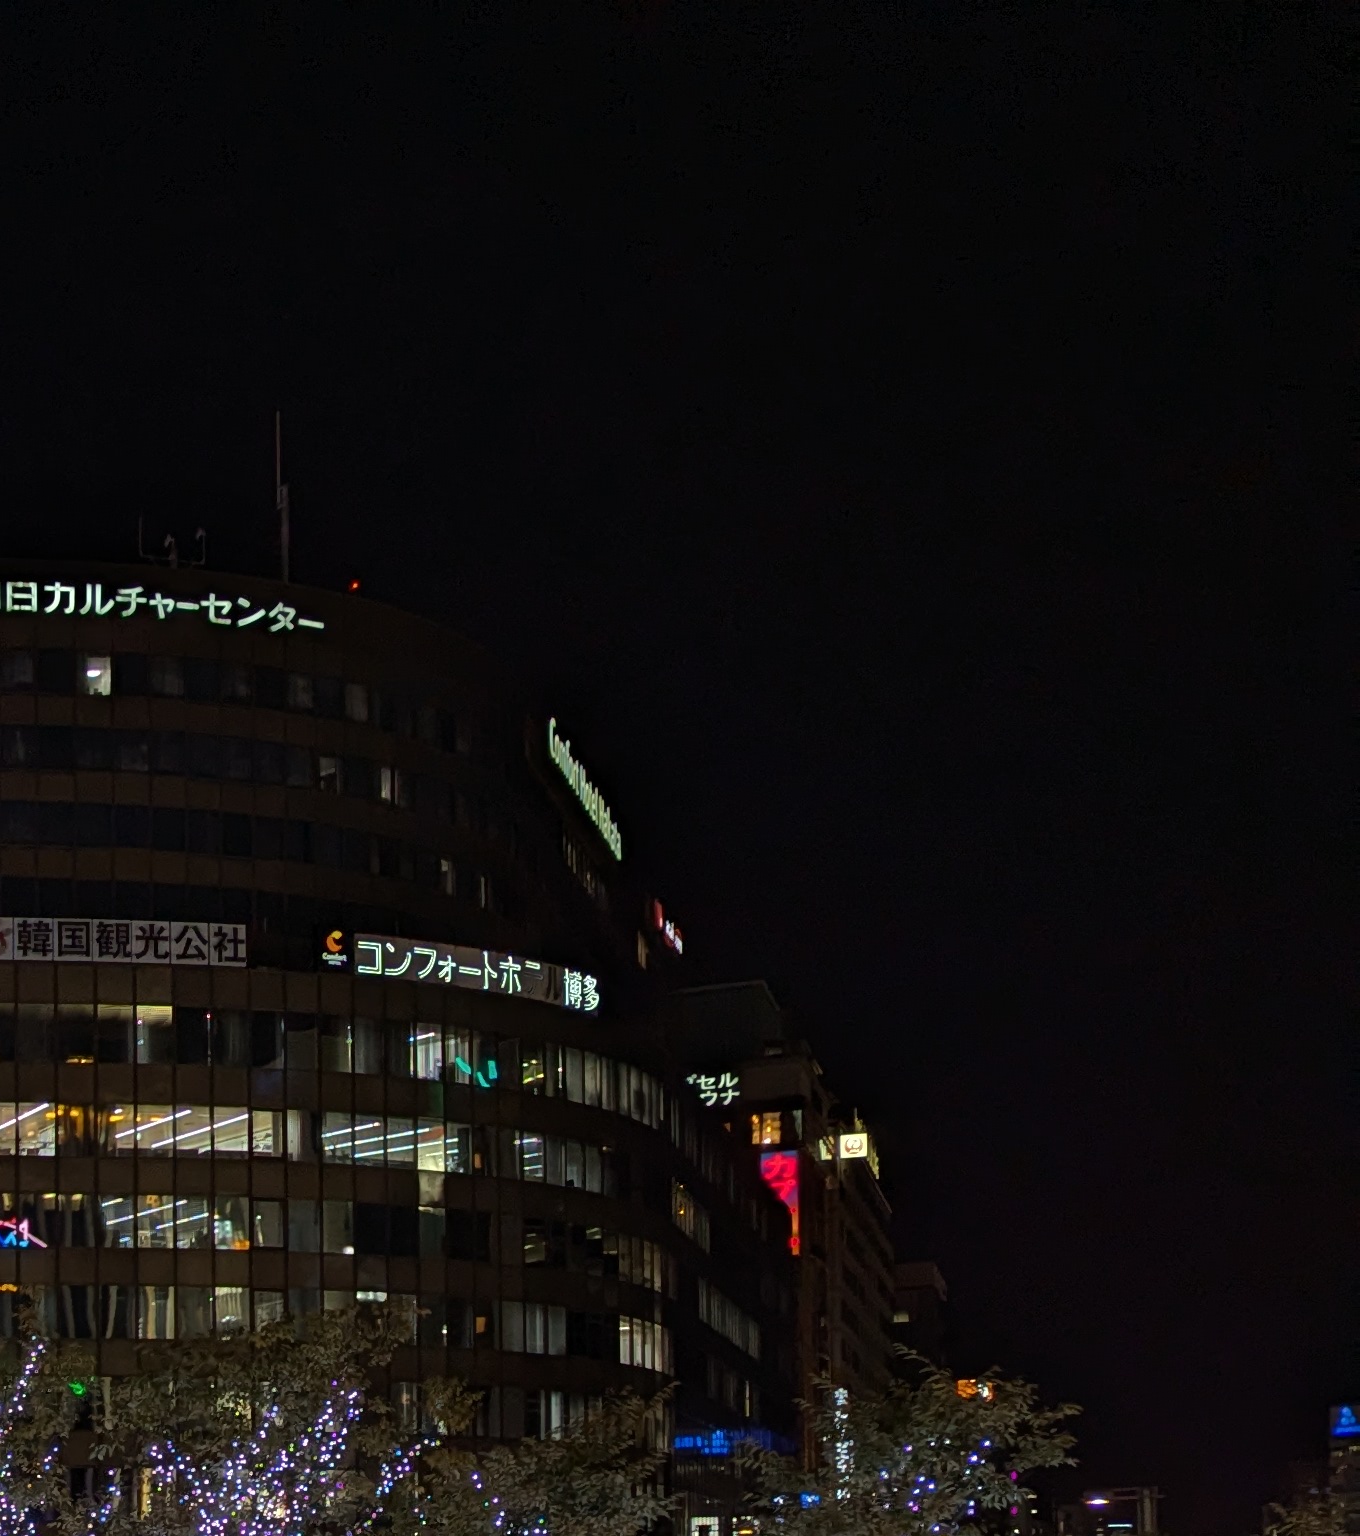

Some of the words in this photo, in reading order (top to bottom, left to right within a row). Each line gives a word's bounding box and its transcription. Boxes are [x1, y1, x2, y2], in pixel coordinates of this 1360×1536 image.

[16, 920, 247, 964] 韓国観光公社
[357, 940, 600, 1011] コンフォートホテル博多
